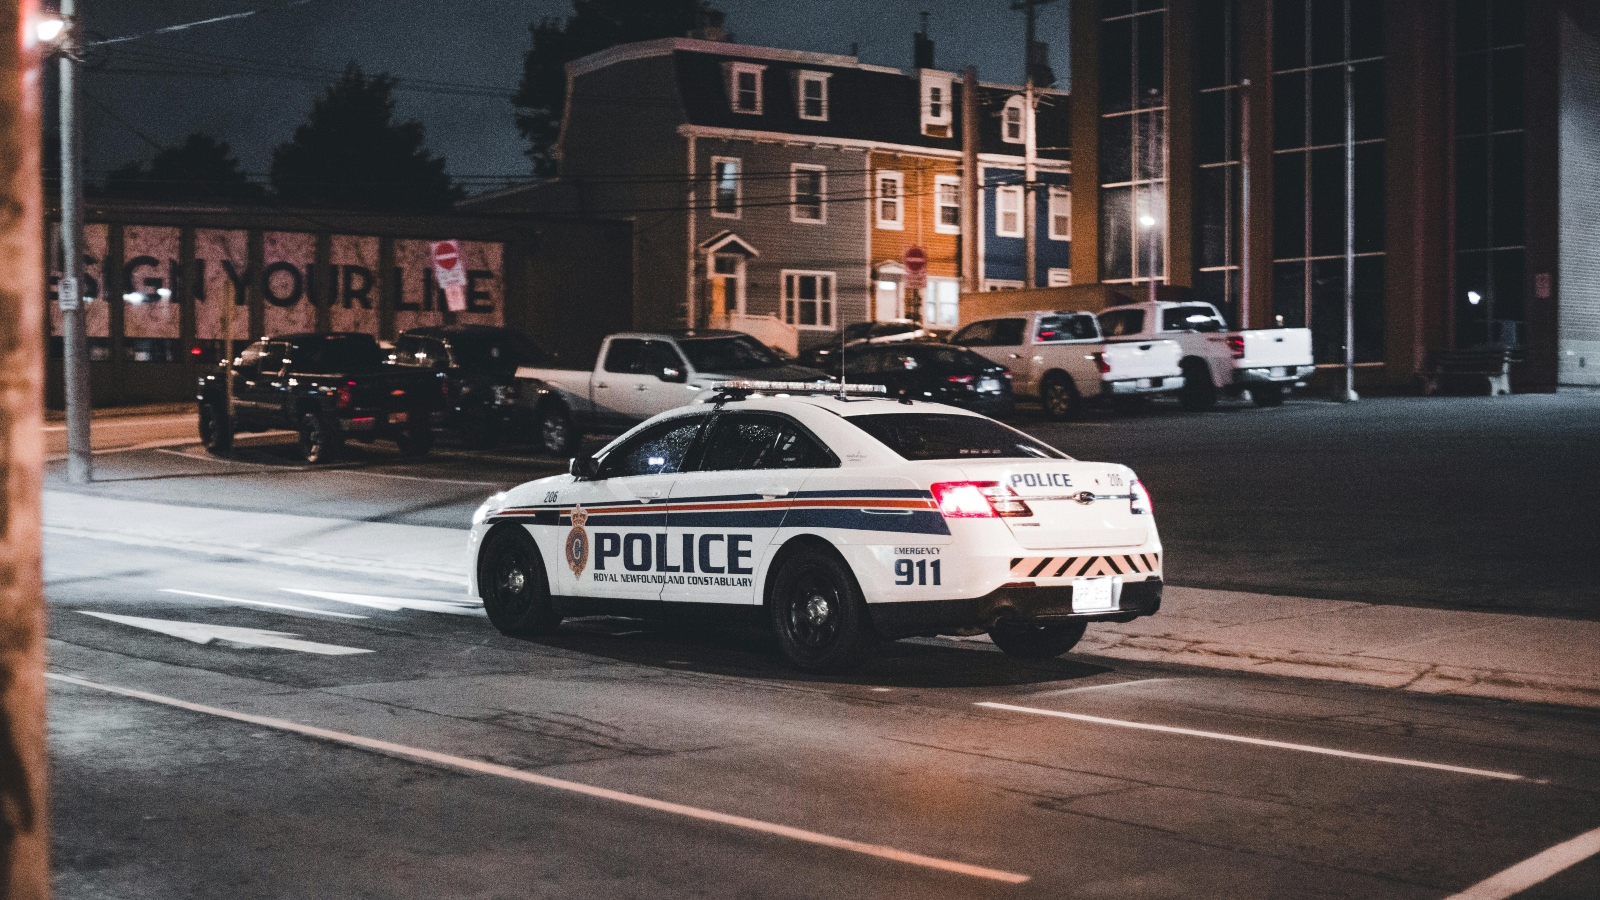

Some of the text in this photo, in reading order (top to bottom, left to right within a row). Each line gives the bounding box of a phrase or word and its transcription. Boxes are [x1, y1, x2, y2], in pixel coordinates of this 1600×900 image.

[221, 259, 375, 310] YOUR
[394, 266, 495, 314] LIE
[1010, 473, 1073, 487] POLICE
[1107, 473, 1123, 487] 206
[544, 491, 559, 503] 206
[594, 532, 753, 575] POLICE
[894, 547, 941, 555] EMERGENCY
[894, 558, 941, 586] 911
[593, 572, 754, 587] ROYAL NEWFOUNDLAND CONSTABULARY
